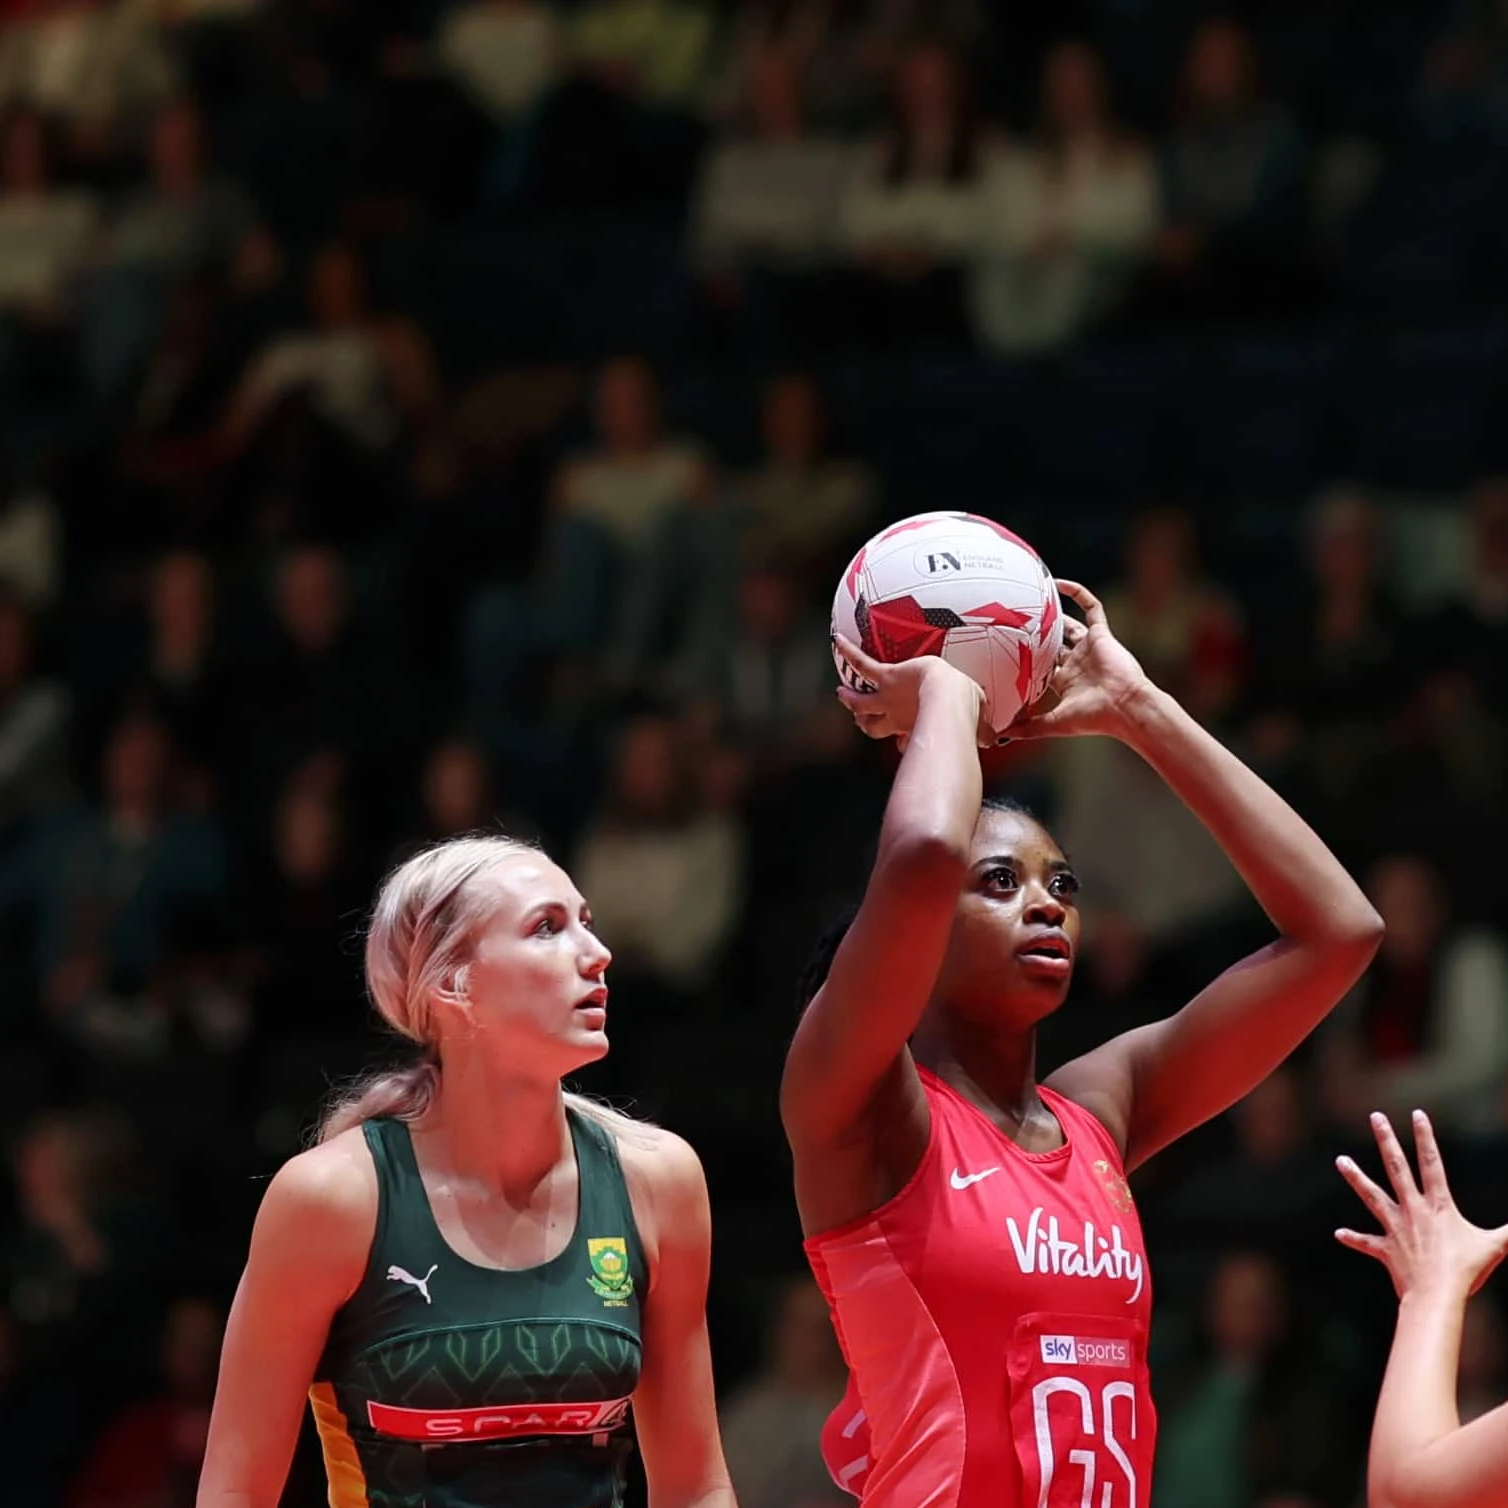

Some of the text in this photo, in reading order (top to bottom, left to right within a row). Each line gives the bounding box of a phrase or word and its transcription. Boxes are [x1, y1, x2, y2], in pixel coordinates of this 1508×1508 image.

[1006, 1208, 1144, 1305] Vitality
[1045, 1338, 1126, 1362] sky sports
